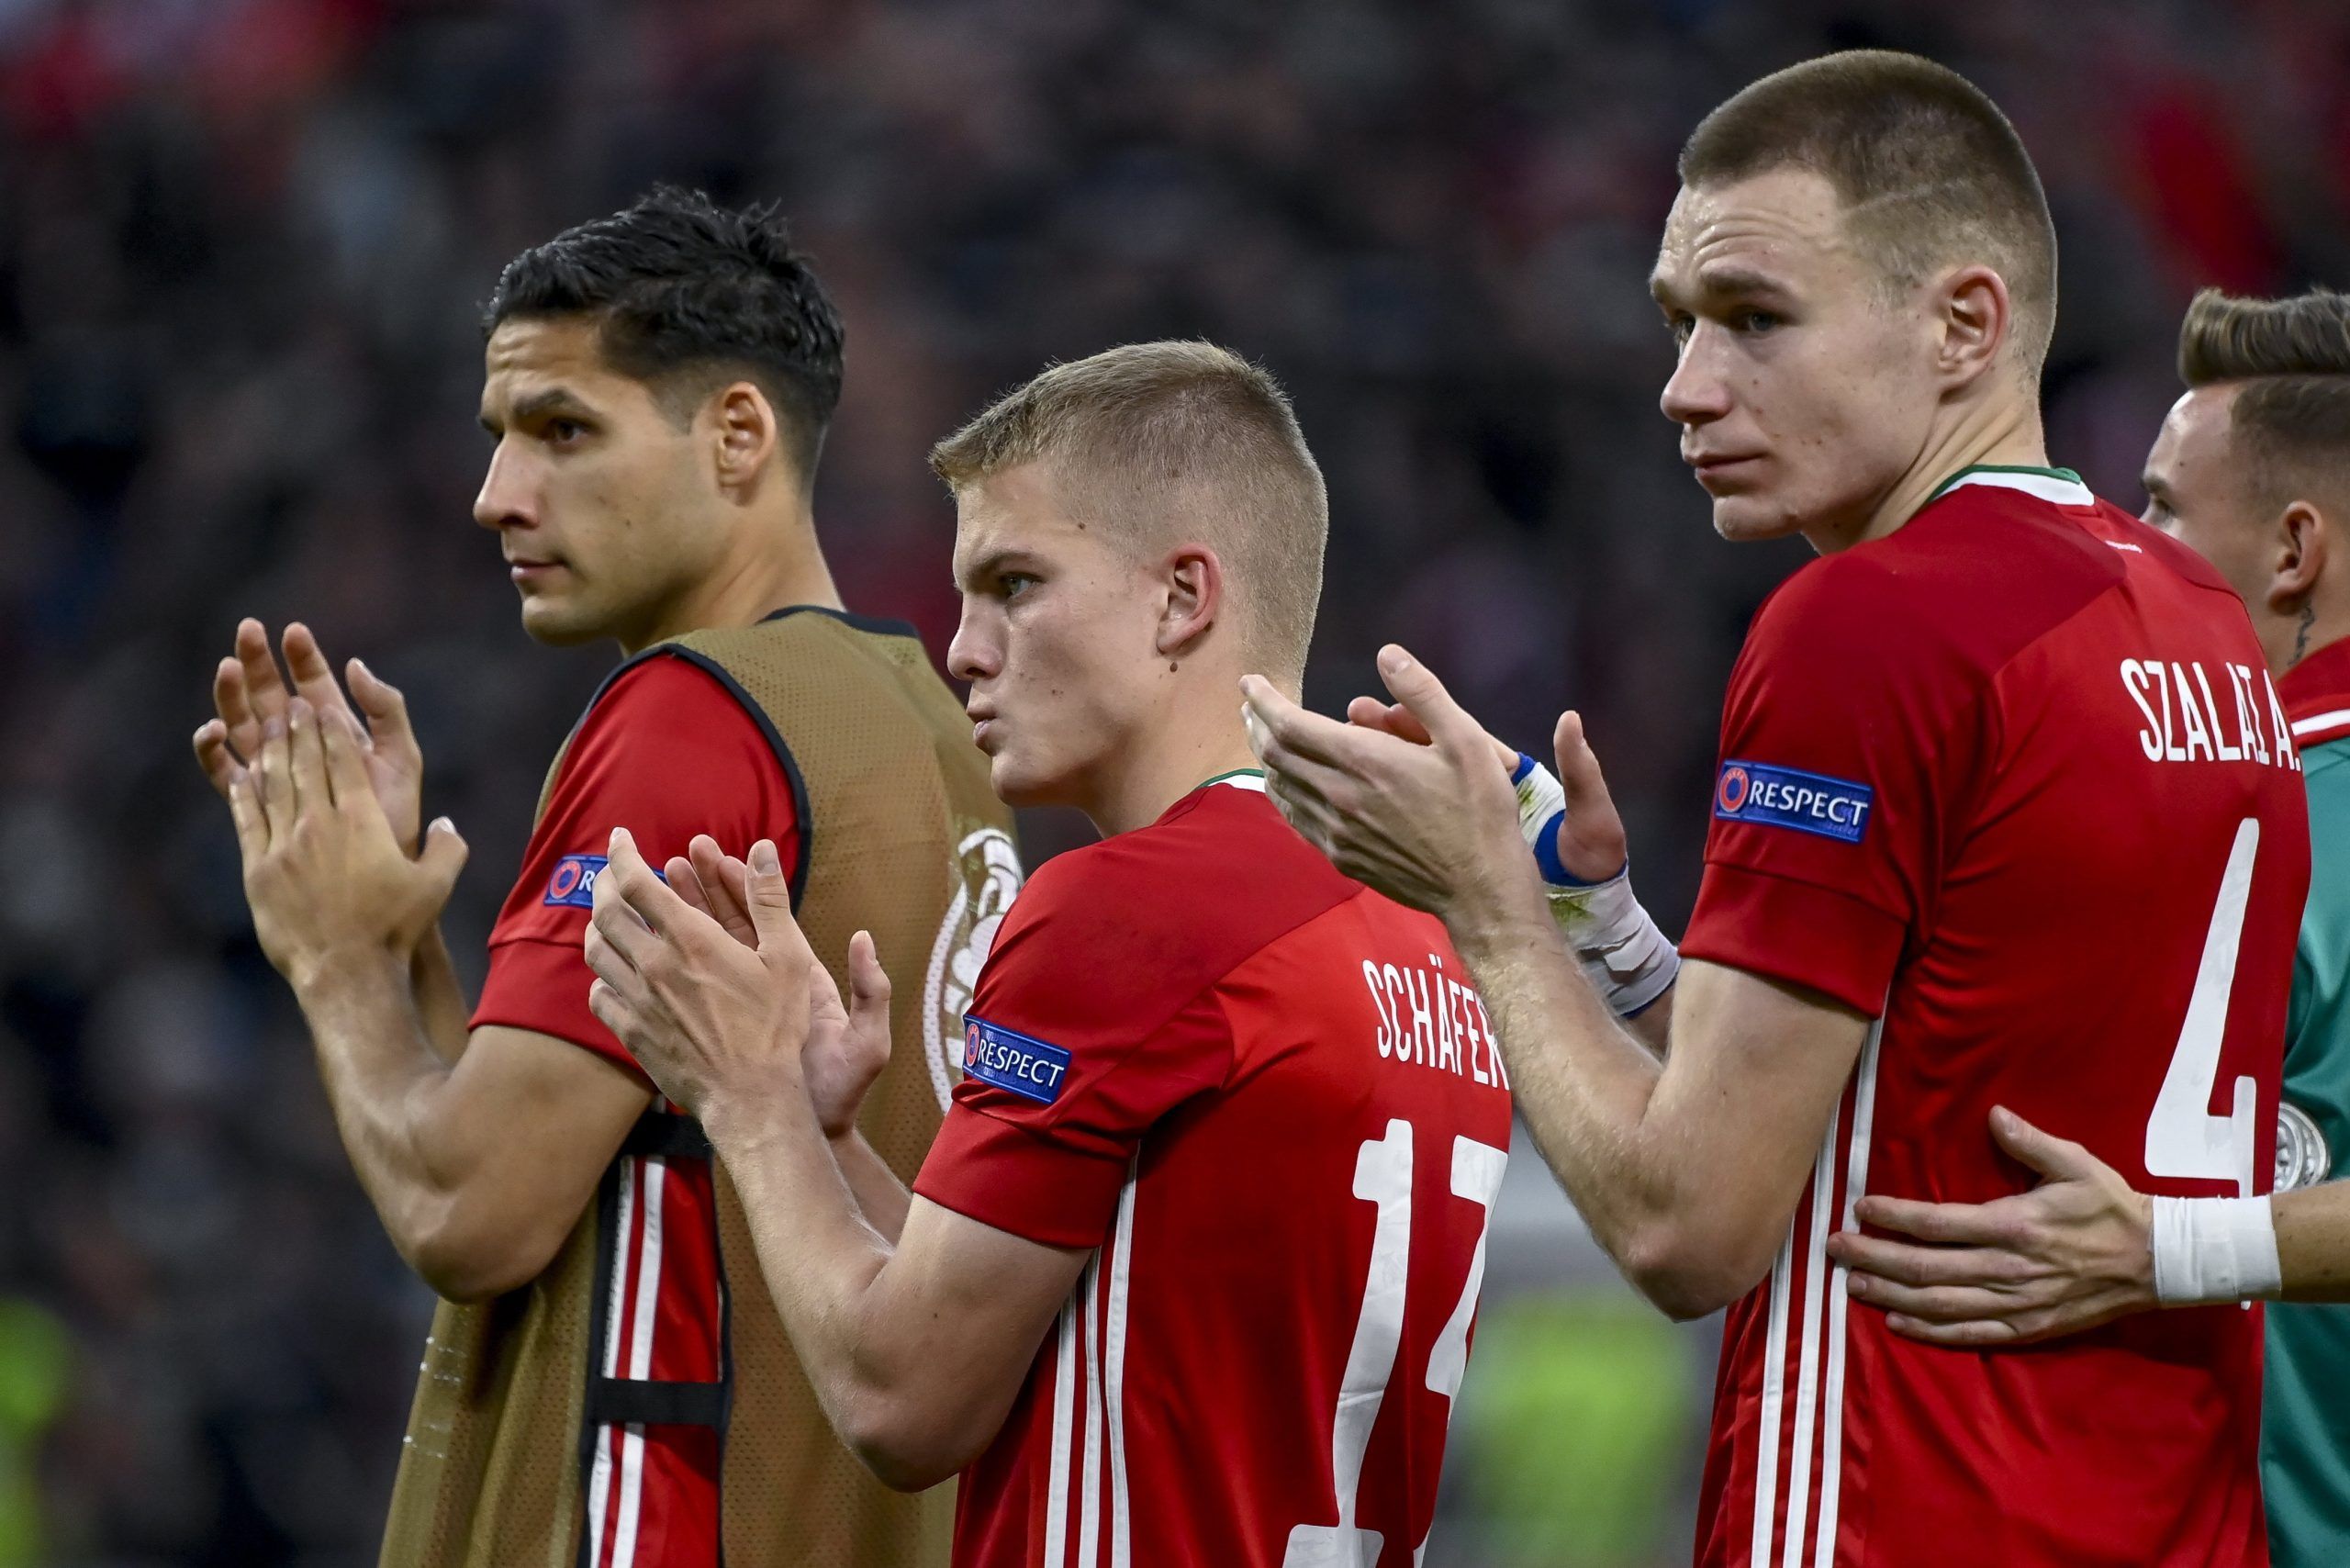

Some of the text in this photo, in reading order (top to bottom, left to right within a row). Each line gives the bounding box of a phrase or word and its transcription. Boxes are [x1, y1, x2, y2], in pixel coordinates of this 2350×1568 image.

[2121, 658, 2301, 771] SZALAI A.
[1749, 780, 1868, 826] RESPECT
[978, 1038, 1065, 1087] RESPECT
[1362, 953, 1510, 1091] SCHÄFER
[2144, 817, 2259, 1197] 4
